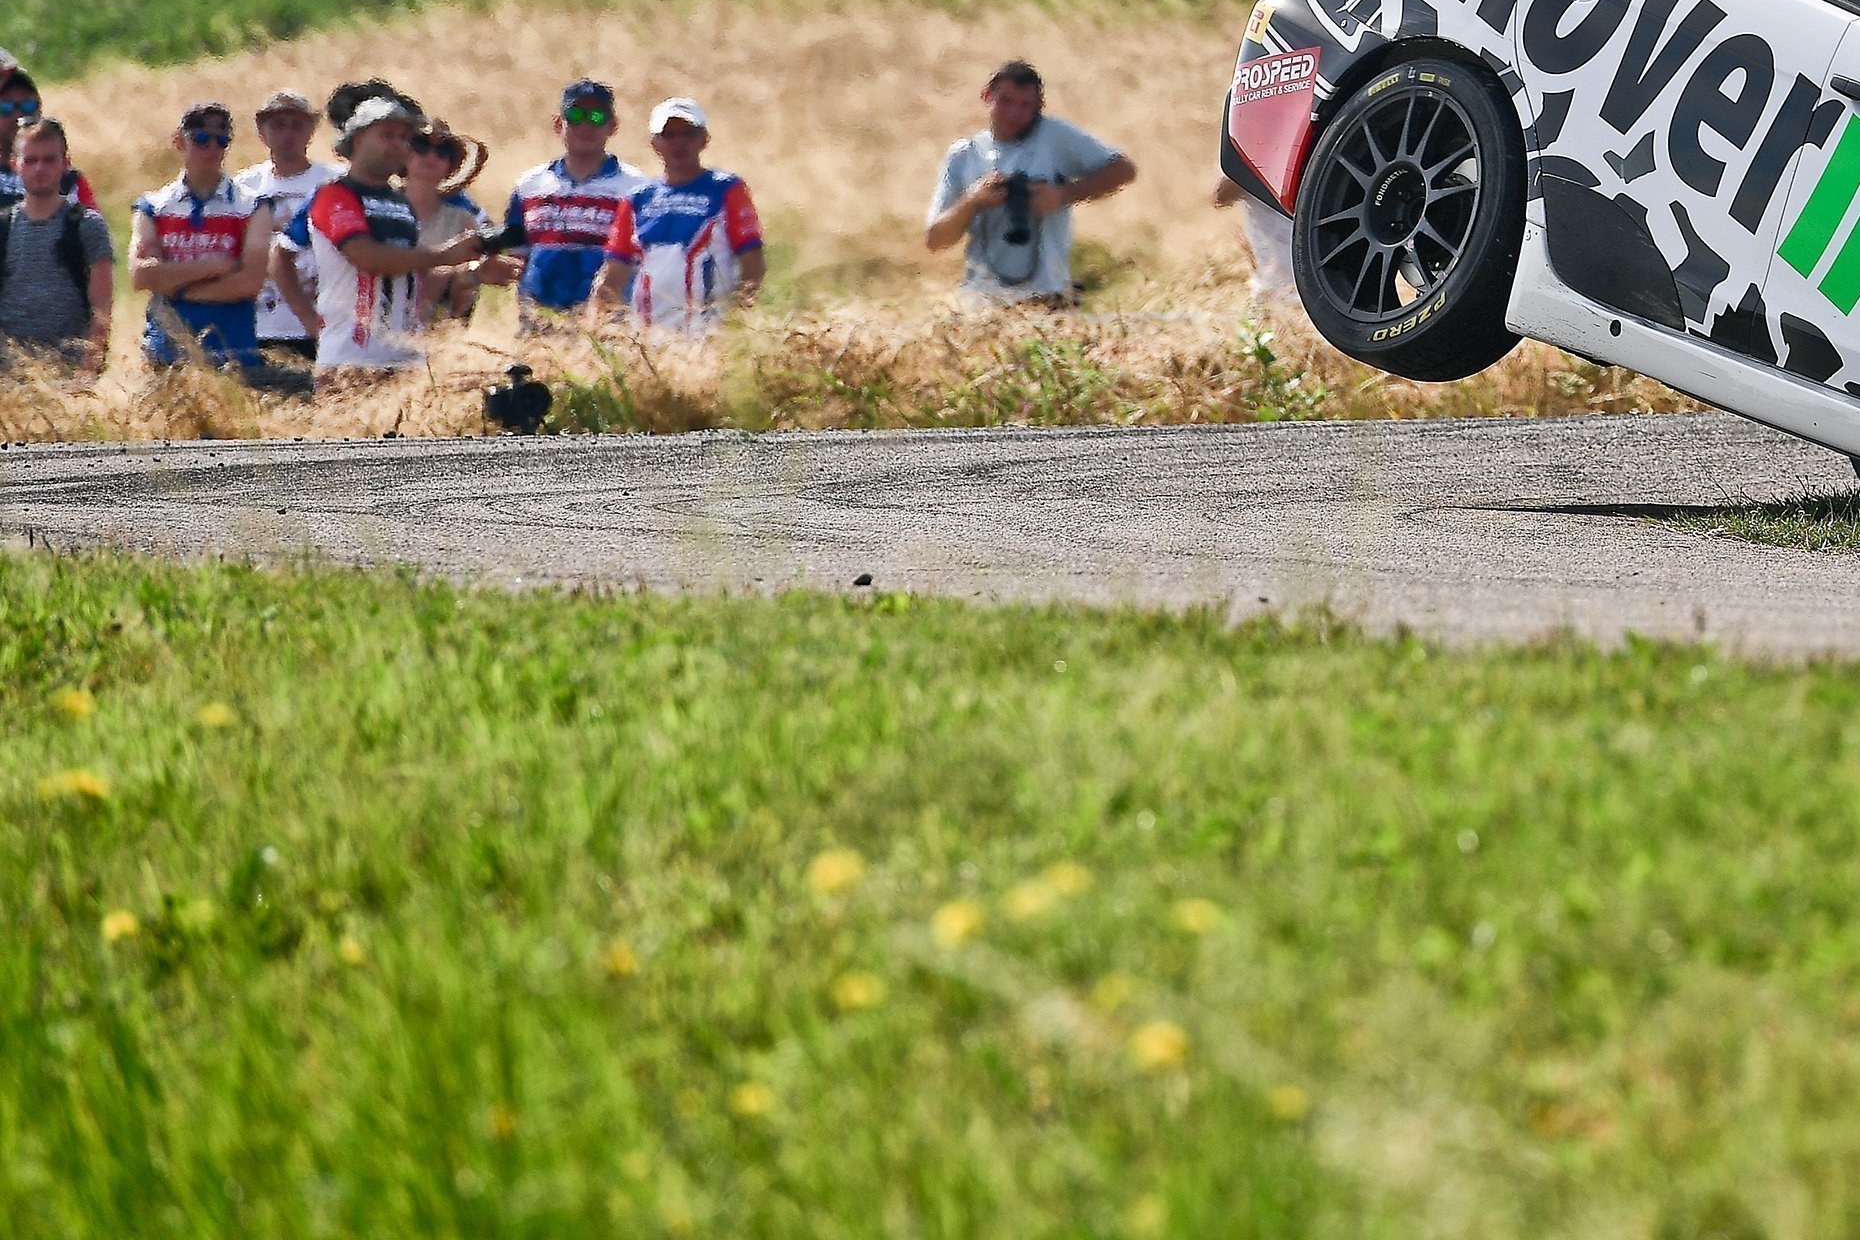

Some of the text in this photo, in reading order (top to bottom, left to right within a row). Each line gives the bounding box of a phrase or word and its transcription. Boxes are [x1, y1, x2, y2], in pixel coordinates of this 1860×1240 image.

[1232, 54, 1315, 94] PROSPEED
[1248, 90, 1260, 101] CAR
[1261, 86, 1278, 98] RENT
[1284, 80, 1311, 93] SERVICE
